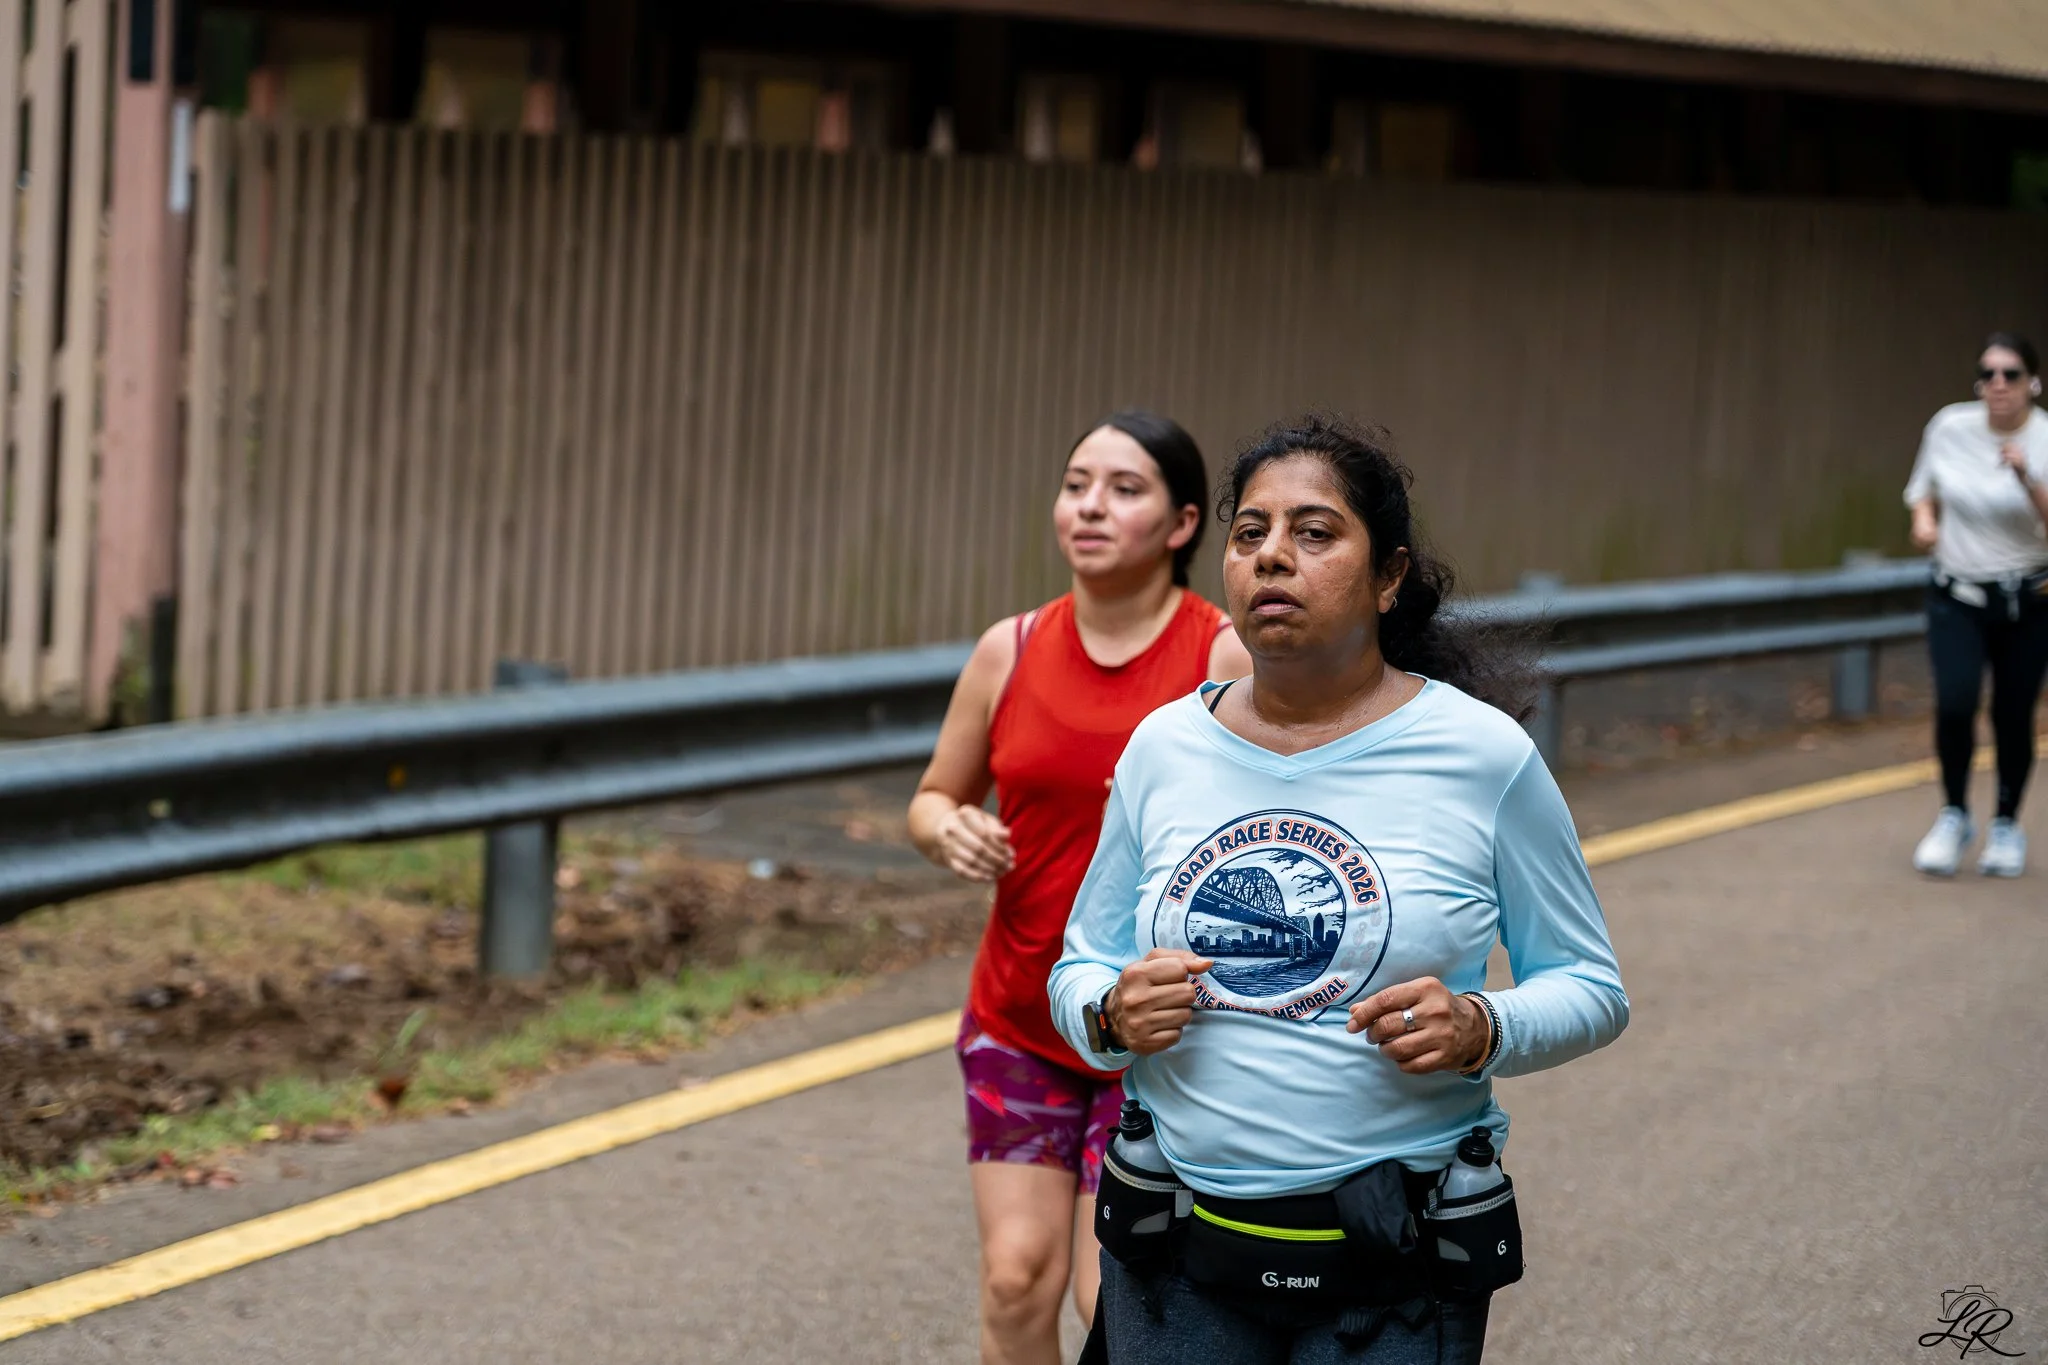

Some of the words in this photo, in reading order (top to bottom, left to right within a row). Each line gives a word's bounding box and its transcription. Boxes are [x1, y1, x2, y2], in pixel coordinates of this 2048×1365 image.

[1167, 847, 1216, 903] ROAD
[1215, 820, 1272, 856] RACE
[1275, 819, 1349, 862] SERIES
[1337, 853, 1380, 905] 2026
[1271, 976, 1349, 1020] MEMORIAL
[1261, 1271, 1320, 1289] G-RUN
